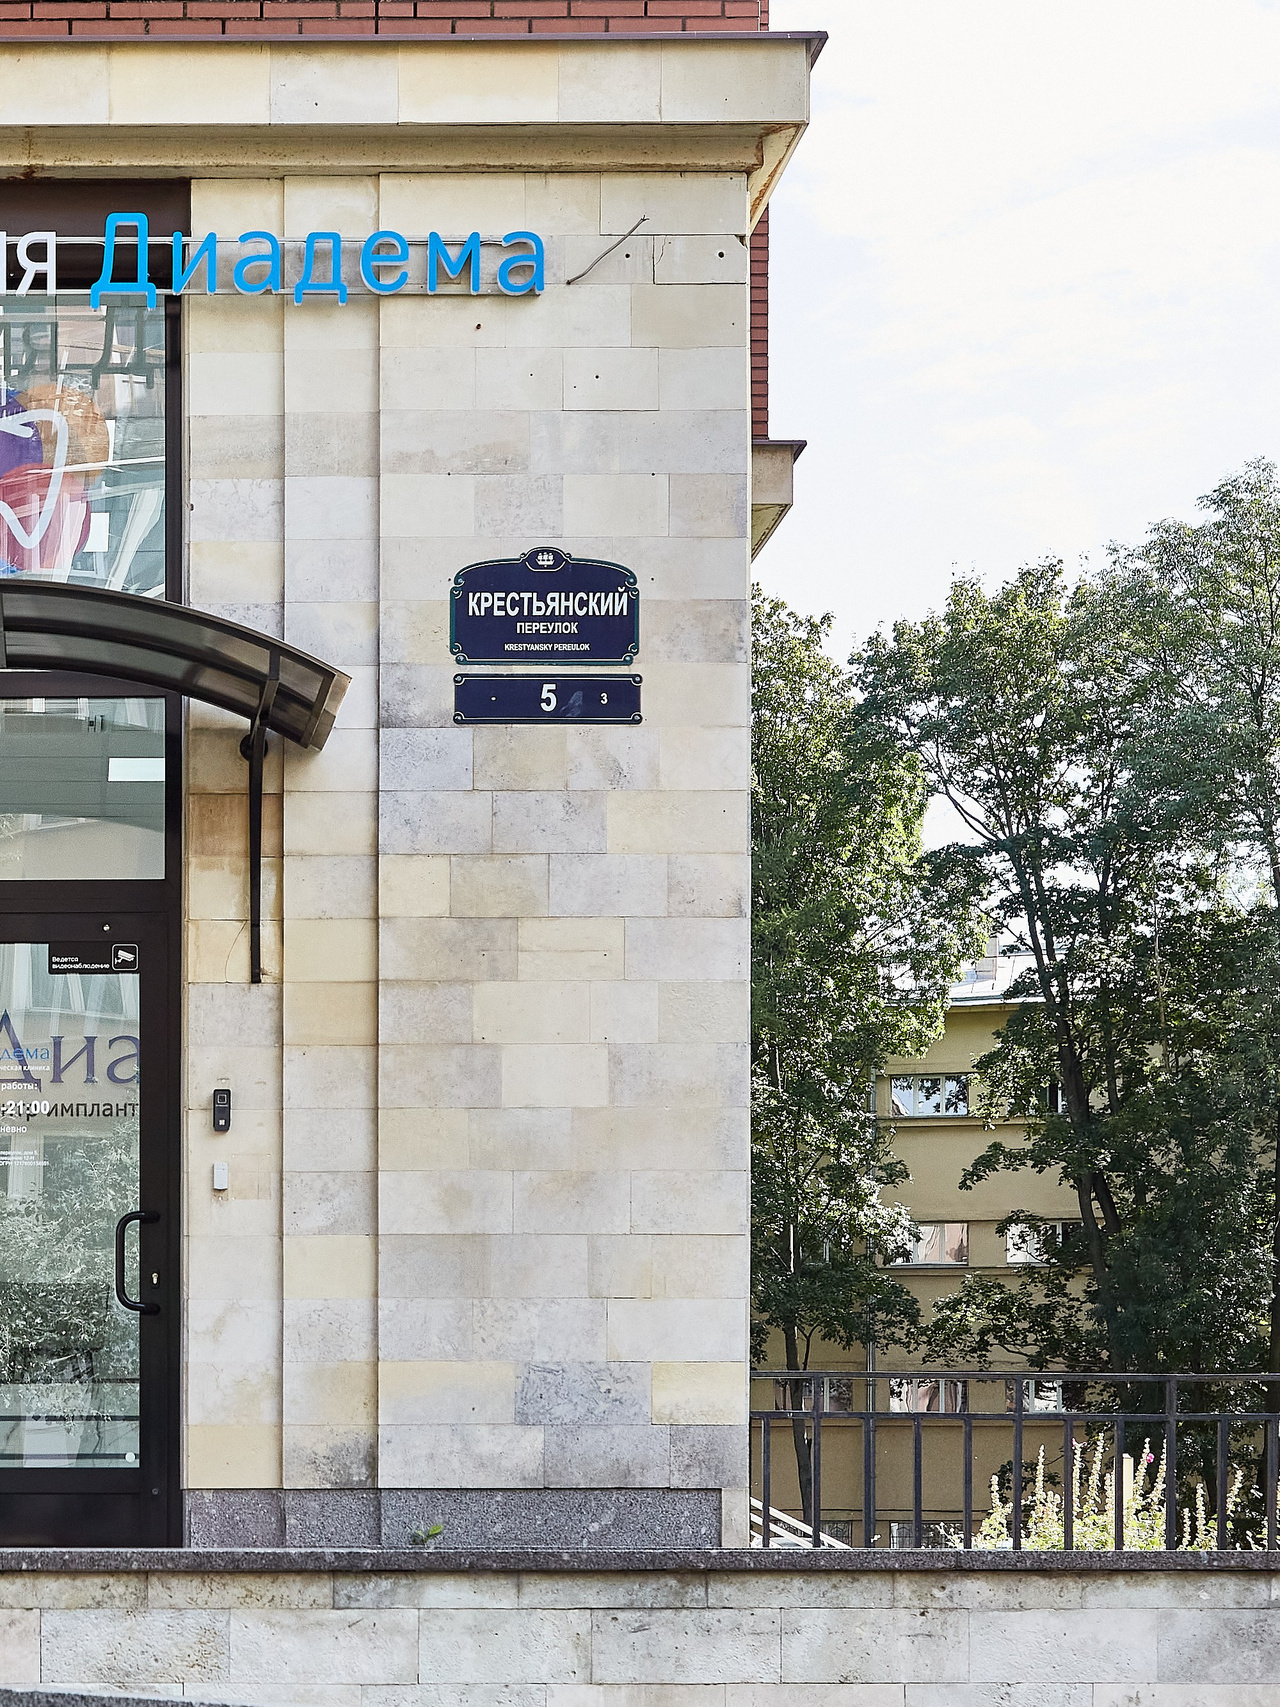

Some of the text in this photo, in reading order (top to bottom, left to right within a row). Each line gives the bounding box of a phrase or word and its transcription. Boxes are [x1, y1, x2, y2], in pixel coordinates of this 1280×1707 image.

[90, 212, 545, 311] Диадема
[468, 587, 628, 616] КРЕСТЬЯНСКИЙ
[516, 622, 579, 634] ПЕРЕУЛОК
[504, 643, 591, 651] KRESTYANSKY PEREULOK
[540, 684, 608, 712] 5 3
[1, 1081, 38, 1091] работы:
